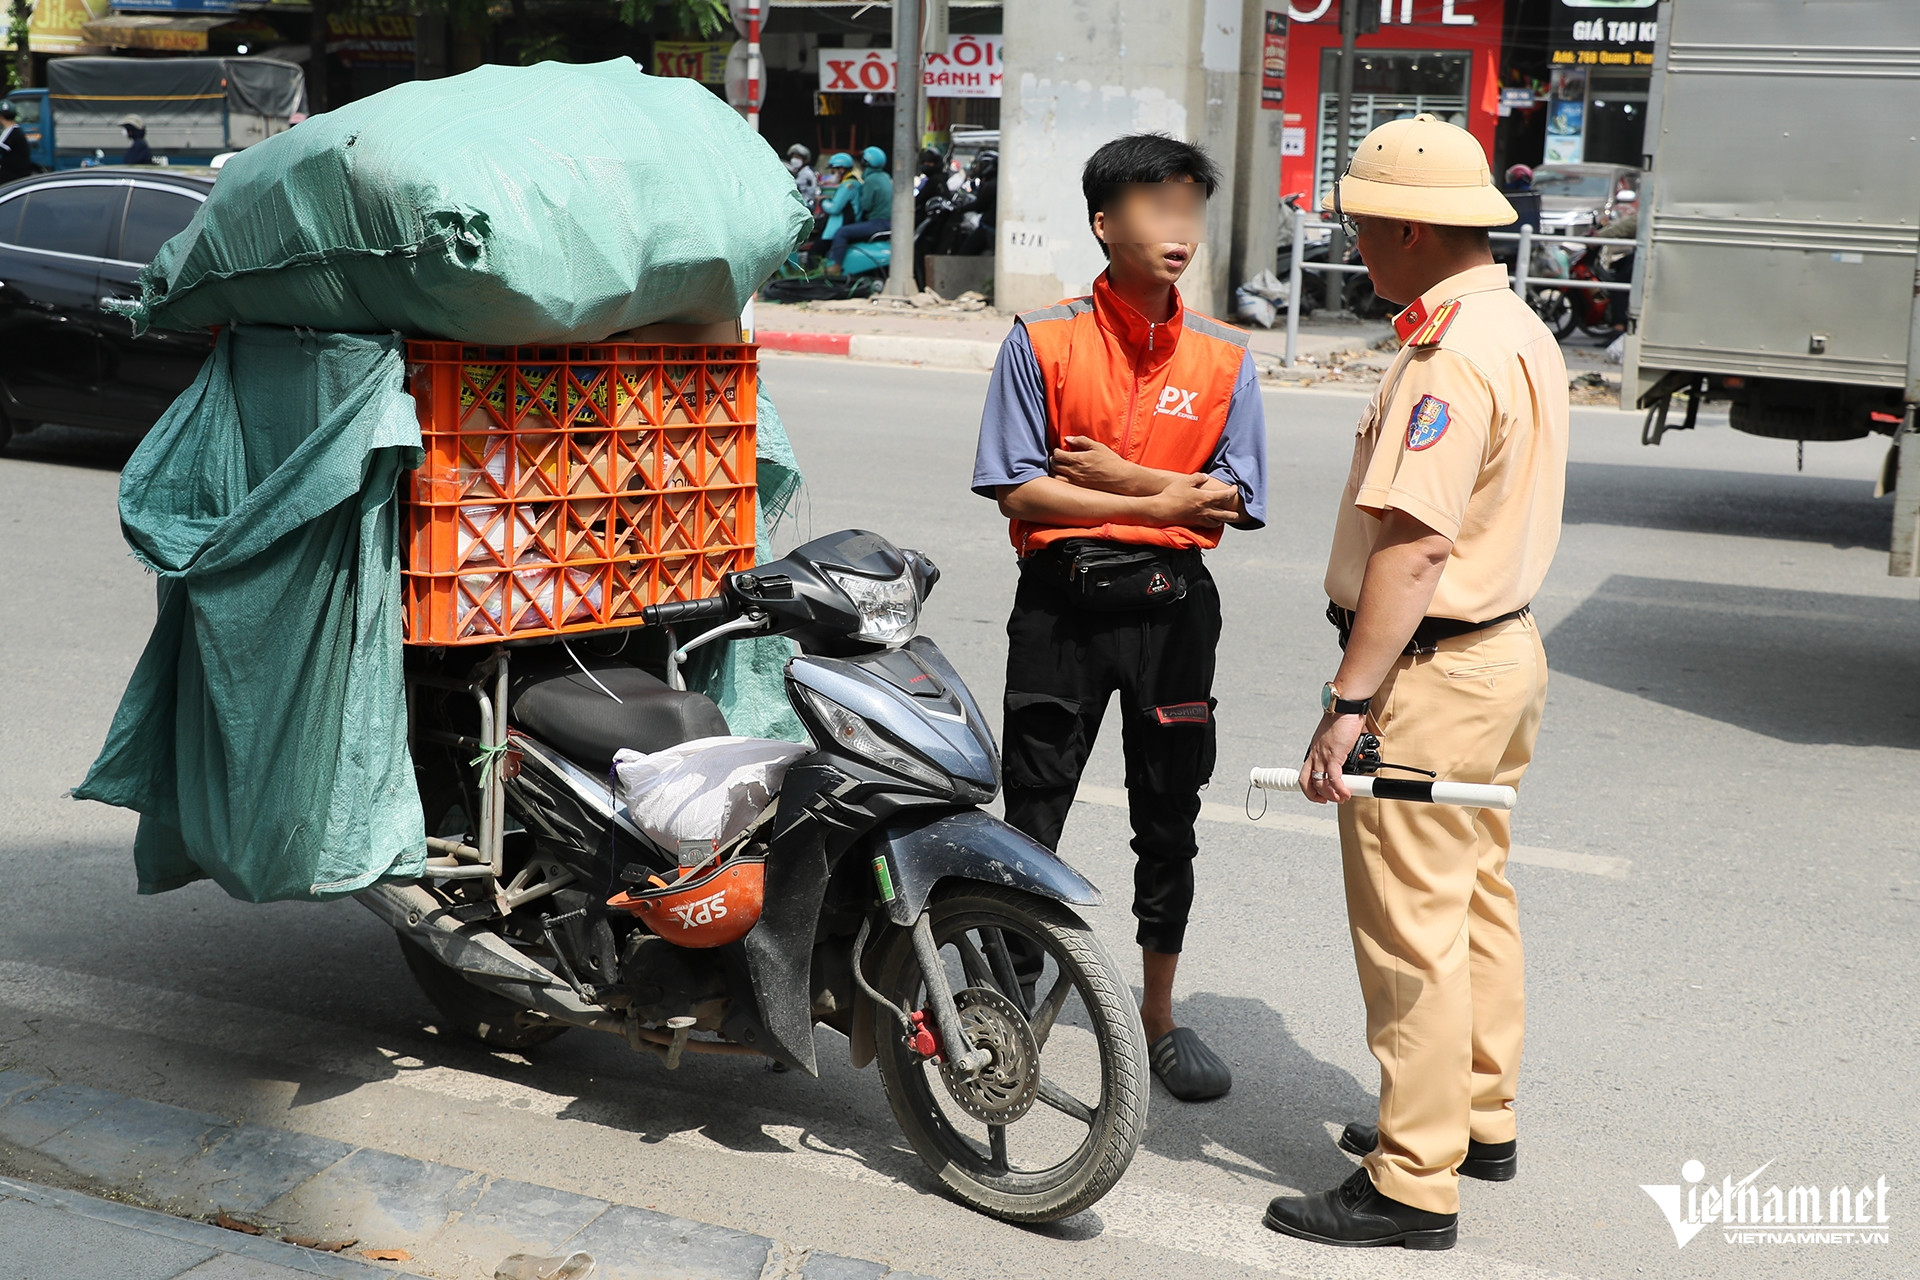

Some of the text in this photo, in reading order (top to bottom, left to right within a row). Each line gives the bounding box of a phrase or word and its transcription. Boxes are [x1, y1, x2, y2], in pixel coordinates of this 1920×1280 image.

[1573, 18, 1604, 41] GIÁ
[1607, 21, 1637, 45] TẠI
[826, 52, 897, 91] XÔ
[675, 897, 728, 930] SPX
